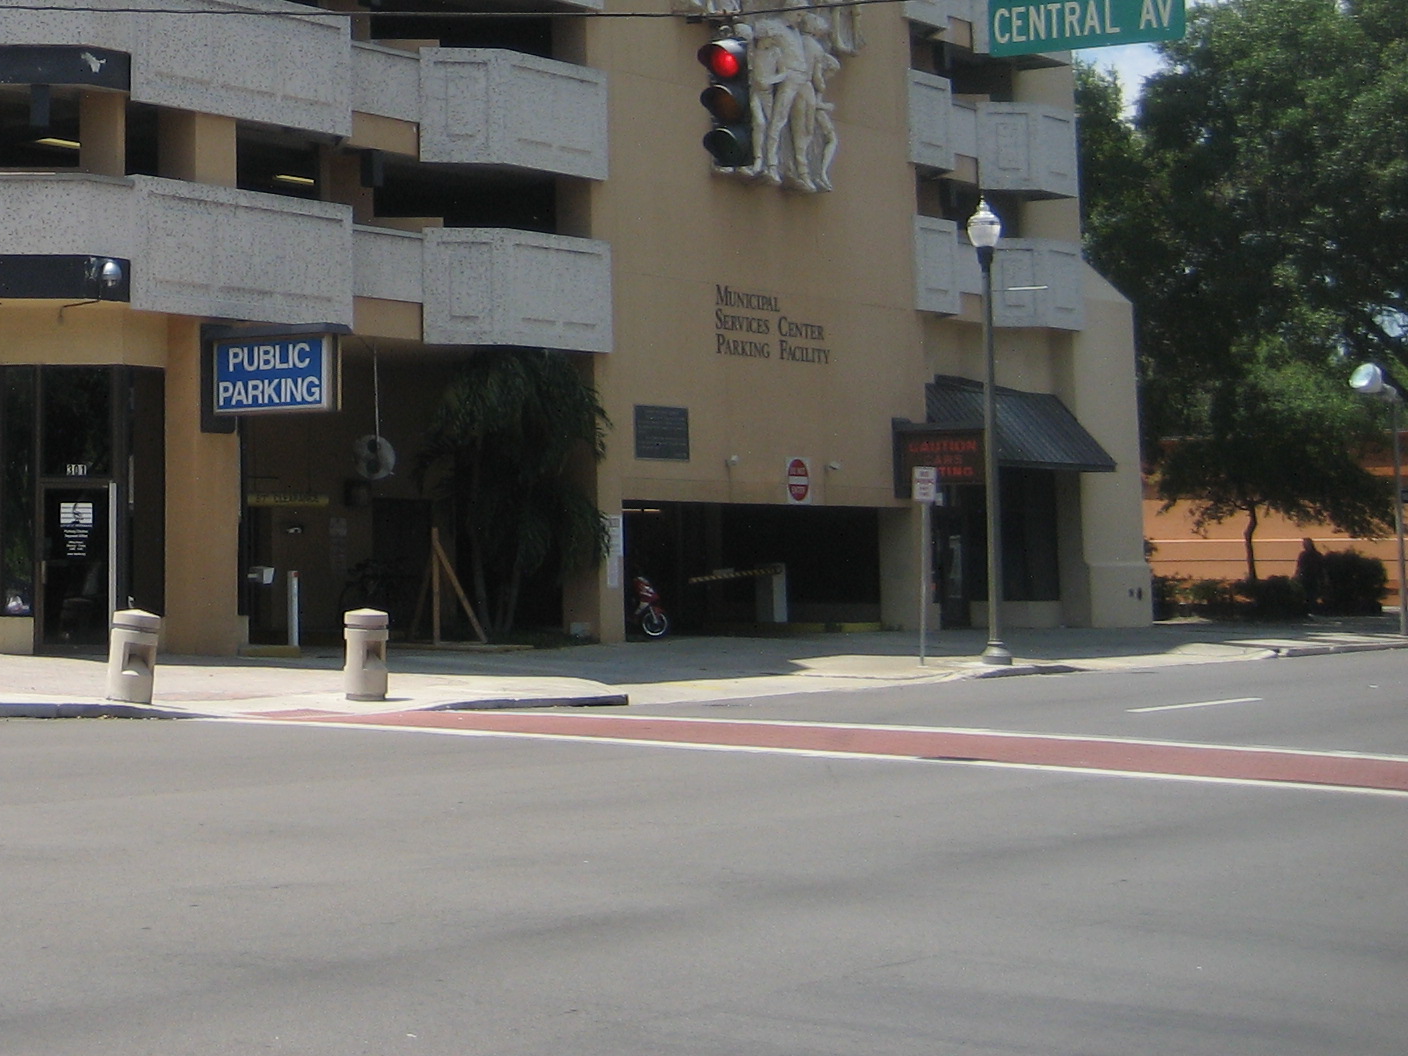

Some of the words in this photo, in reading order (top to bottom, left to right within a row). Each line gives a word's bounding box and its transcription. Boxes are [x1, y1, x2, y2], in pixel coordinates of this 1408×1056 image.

[715, 284, 780, 312] MUNICIPAL
[715, 308, 770, 334] SERVICES
[778, 316, 824, 340] CENTER
[228, 342, 310, 372] PUBLIC
[715, 333, 770, 359] PARKING
[778, 339, 830, 364] FACILITY
[218, 376, 320, 406] PARKING
